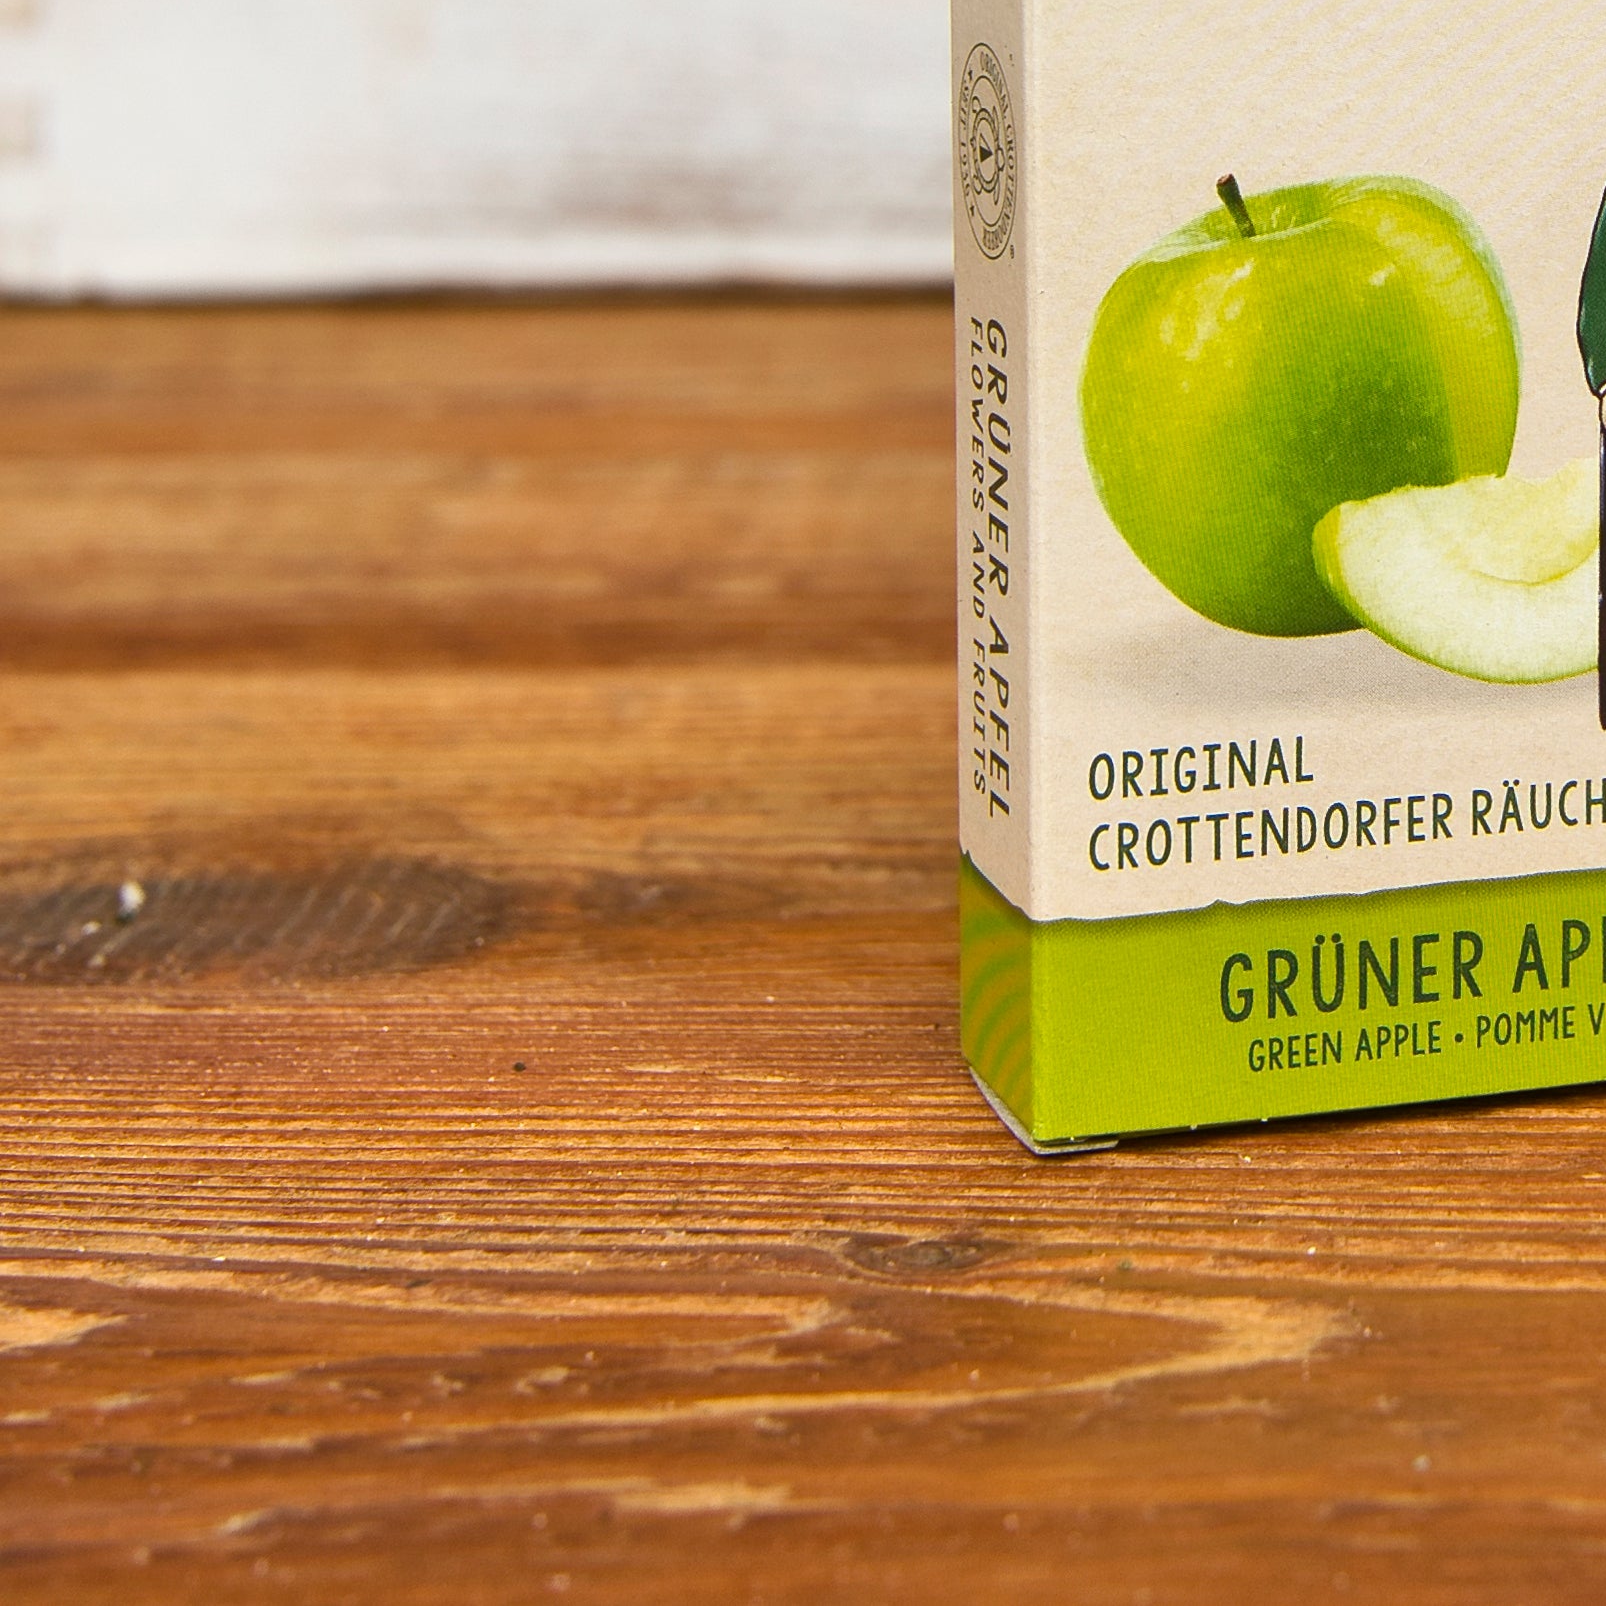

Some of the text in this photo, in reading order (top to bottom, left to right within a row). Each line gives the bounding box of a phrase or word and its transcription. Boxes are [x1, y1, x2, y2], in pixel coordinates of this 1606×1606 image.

[970, 316, 986, 794] FLOWERS AND FRUITS
[987, 318, 1012, 817] GRÜNER APFEL
[1089, 736, 1315, 800] ORIGINAL
[1088, 792, 1454, 871] CROTTENDORFER
[1219, 933, 1484, 1024] GRÜNER
[1247, 1021, 1343, 1073] GREEN
[1355, 1016, 1443, 1062] APPLE
[1475, 1004, 1576, 1048] POMME
